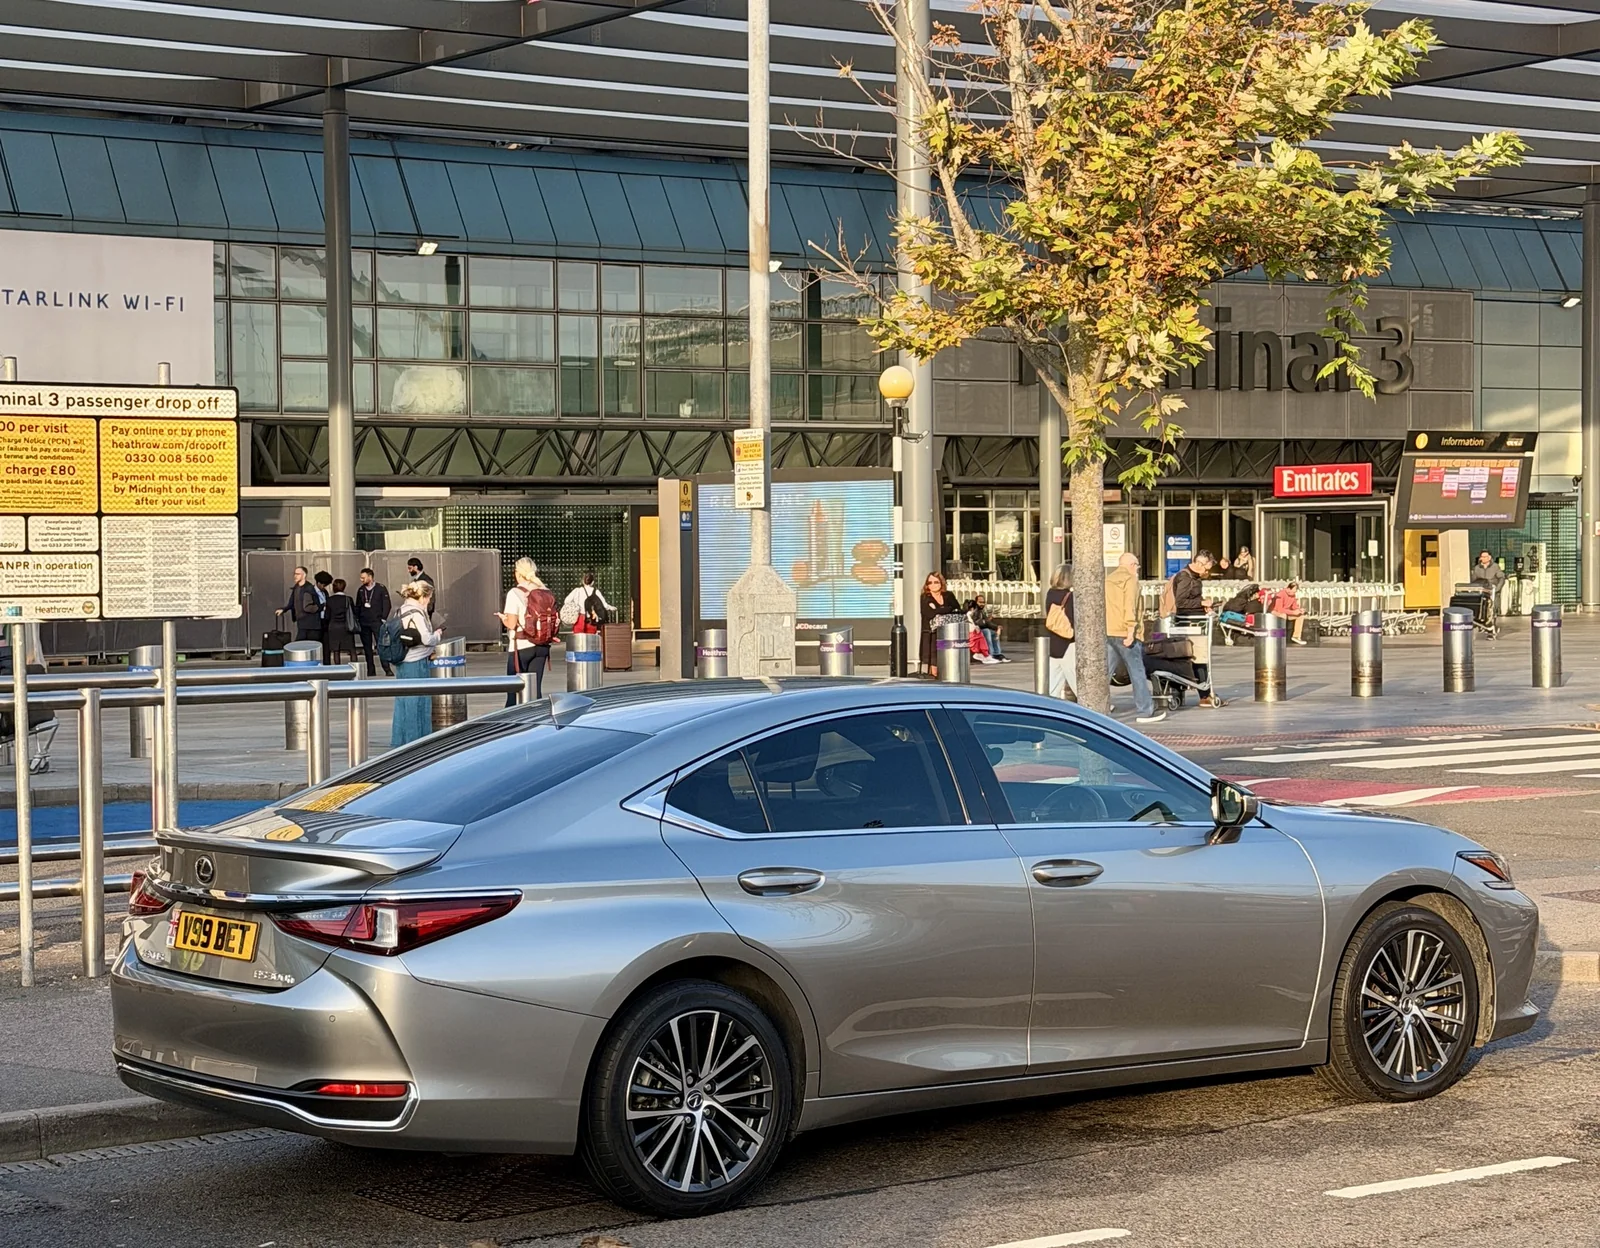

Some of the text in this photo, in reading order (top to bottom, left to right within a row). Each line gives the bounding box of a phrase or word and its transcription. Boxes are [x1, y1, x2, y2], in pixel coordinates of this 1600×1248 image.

[0, 289, 184, 312] TARLINK WI-FI
[1376, 316, 1415, 395] 3
[48, 392, 60, 406] 3
[66, 396, 150, 411] passenger
[155, 396, 192, 411] drop
[197, 397, 220, 410] off
[19, 424, 40, 434] per
[43, 423, 69, 433] visit
[111, 425, 227, 437] Pay online or by phone
[47, 438, 71, 446] (PCN)
[111, 440, 227, 451] heathrow.com/dropoff
[1441, 437, 1485, 447] Information
[125, 453, 215, 464] 0330 008 5600
[5, 464, 76, 476] charge £80
[112, 472, 228, 483] Payment must be made
[1282, 467, 1360, 493] Emirates
[113, 485, 126, 495] by
[129, 484, 173, 495] Midnight
[191, 486, 207, 494] the
[209, 485, 226, 495] day
[135, 497, 206, 507] after your visit
[1421, 535, 1438, 576] F
[0, 560, 93, 571] ANPR in operation
[35, 605, 75, 614] Heathrow
[182, 916, 251, 955] V99 BET
